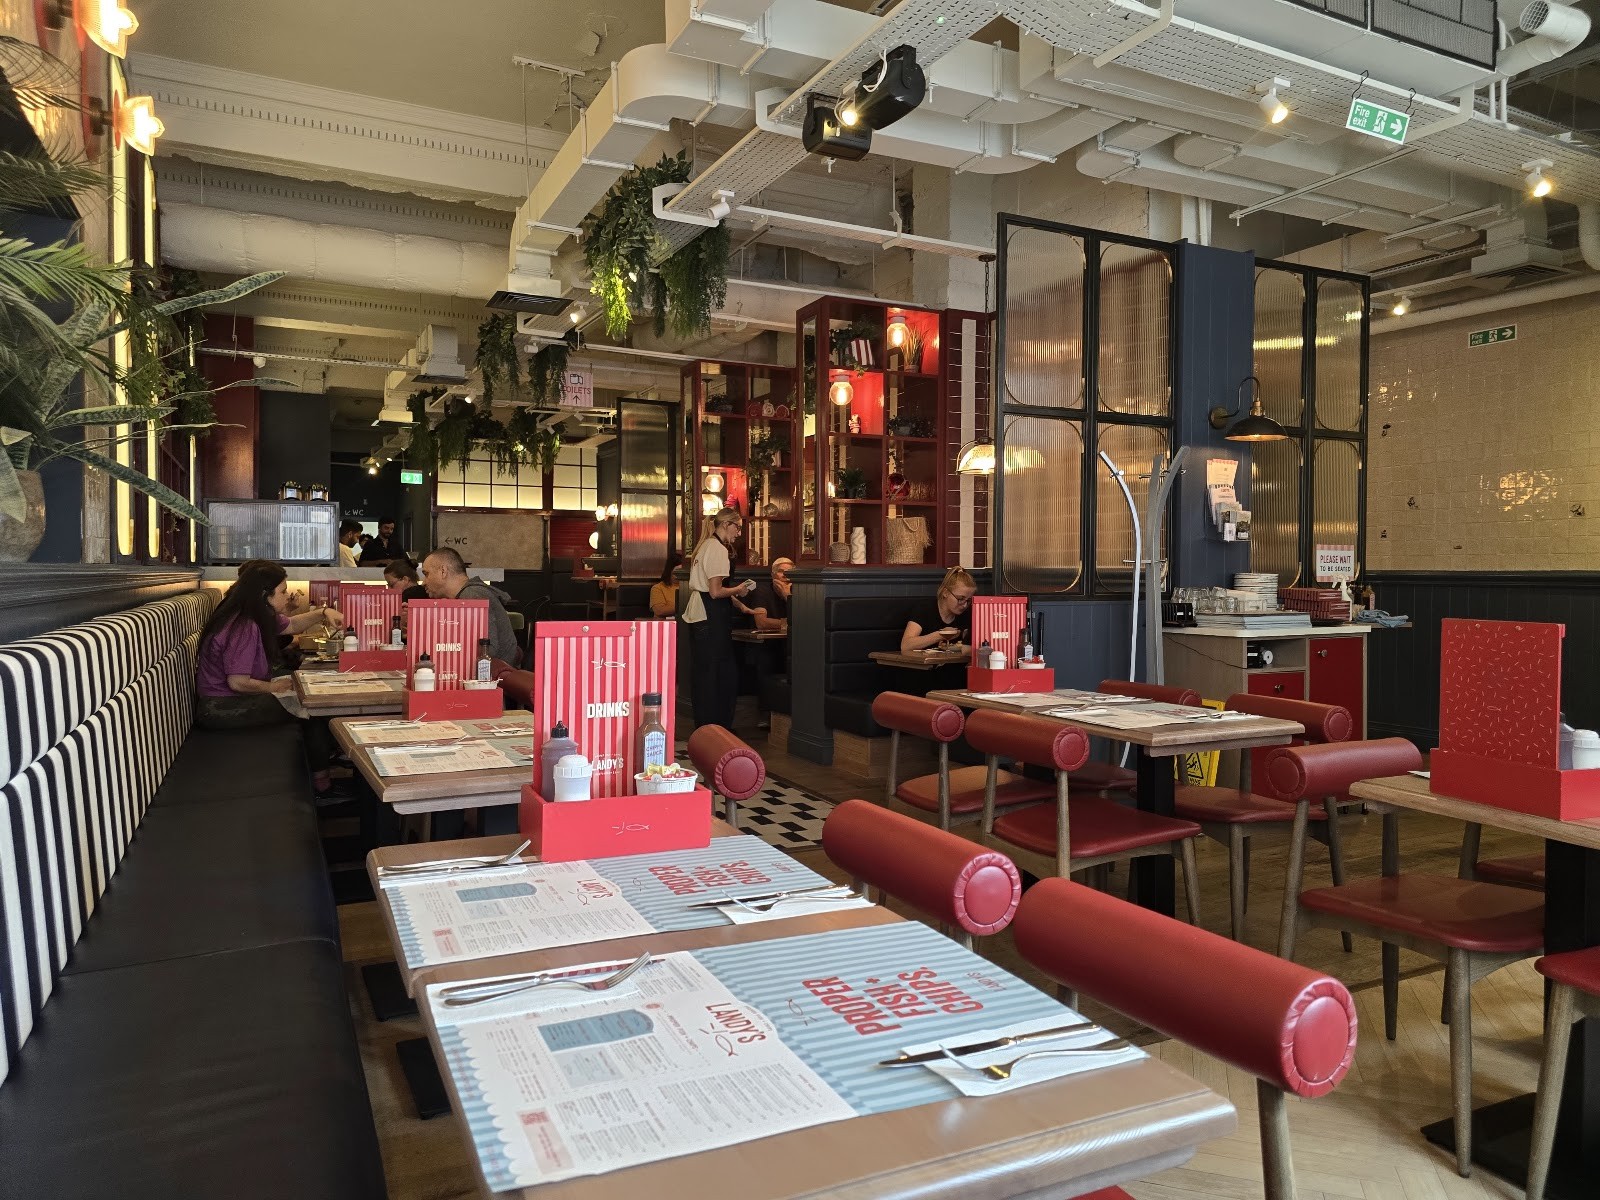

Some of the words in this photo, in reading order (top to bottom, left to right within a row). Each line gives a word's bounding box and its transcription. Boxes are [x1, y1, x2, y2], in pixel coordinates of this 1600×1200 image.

[1354, 104, 1370, 118] Fire
[1352, 117, 1367, 128] exit
[454, 537, 468, 545] WC
[1320, 555, 1338, 563] PLEASE
[436, 643, 461, 652] DRINKS
[587, 702, 630, 718] DRINKS
[591, 757, 624, 771] LANDY'S
[648, 865, 707, 895] PROPER
[690, 868, 738, 887] FISH
[801, 976, 902, 1036] PROPER
[863, 983, 938, 1018] FISH
[705, 1002, 766, 1043] LANDY'S
